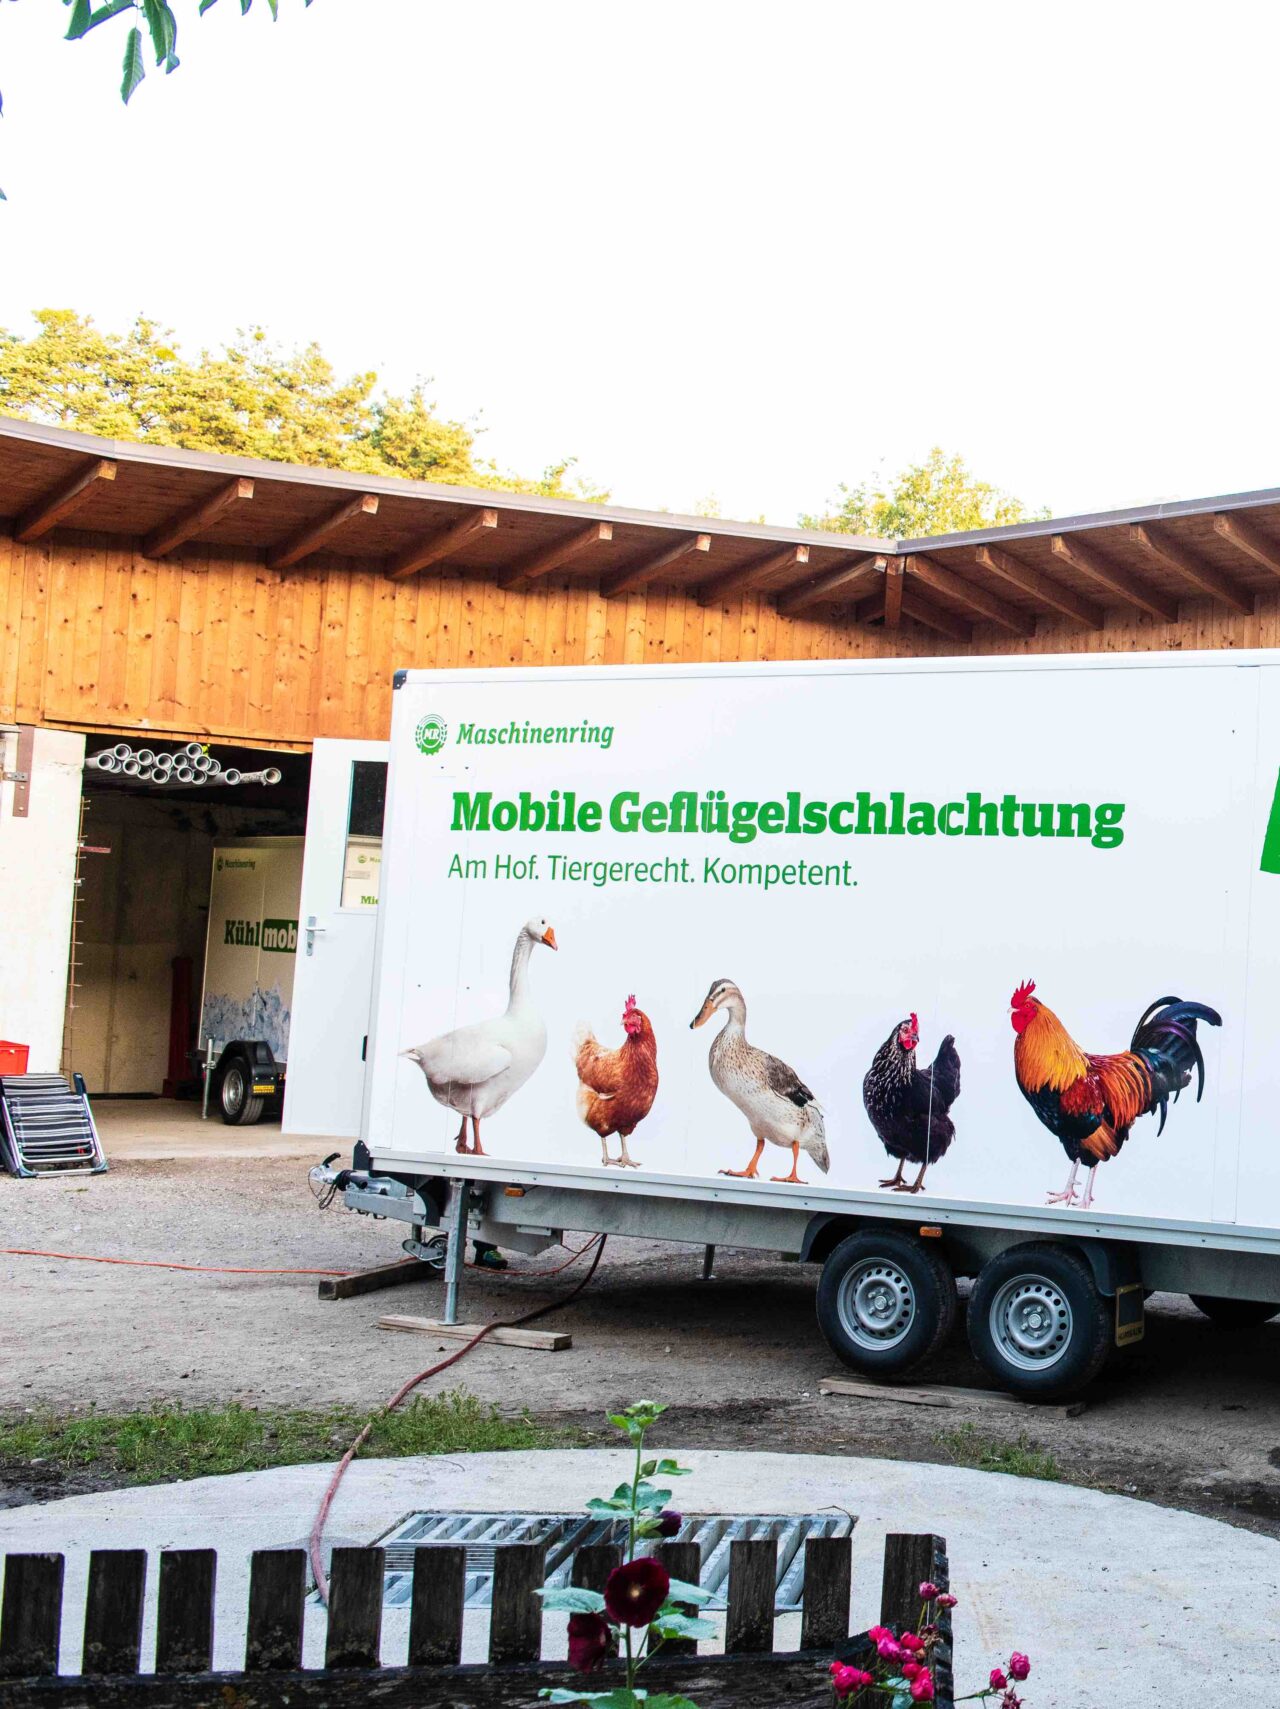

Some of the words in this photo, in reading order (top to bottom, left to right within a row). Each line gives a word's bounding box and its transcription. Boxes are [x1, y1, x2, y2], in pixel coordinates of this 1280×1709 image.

[423, 728, 440, 740] MR
[456, 720, 614, 749] Maschinenring
[449, 790, 603, 833] Mobile
[608, 789, 1126, 850] Geflügelschlachtung
[448, 853, 486, 880] Am
[494, 854, 538, 880] Hof.
[545, 855, 694, 888] Tiergerecht.
[703, 857, 858, 891] Kompetent.
[223, 920, 261, 946] Kühl
